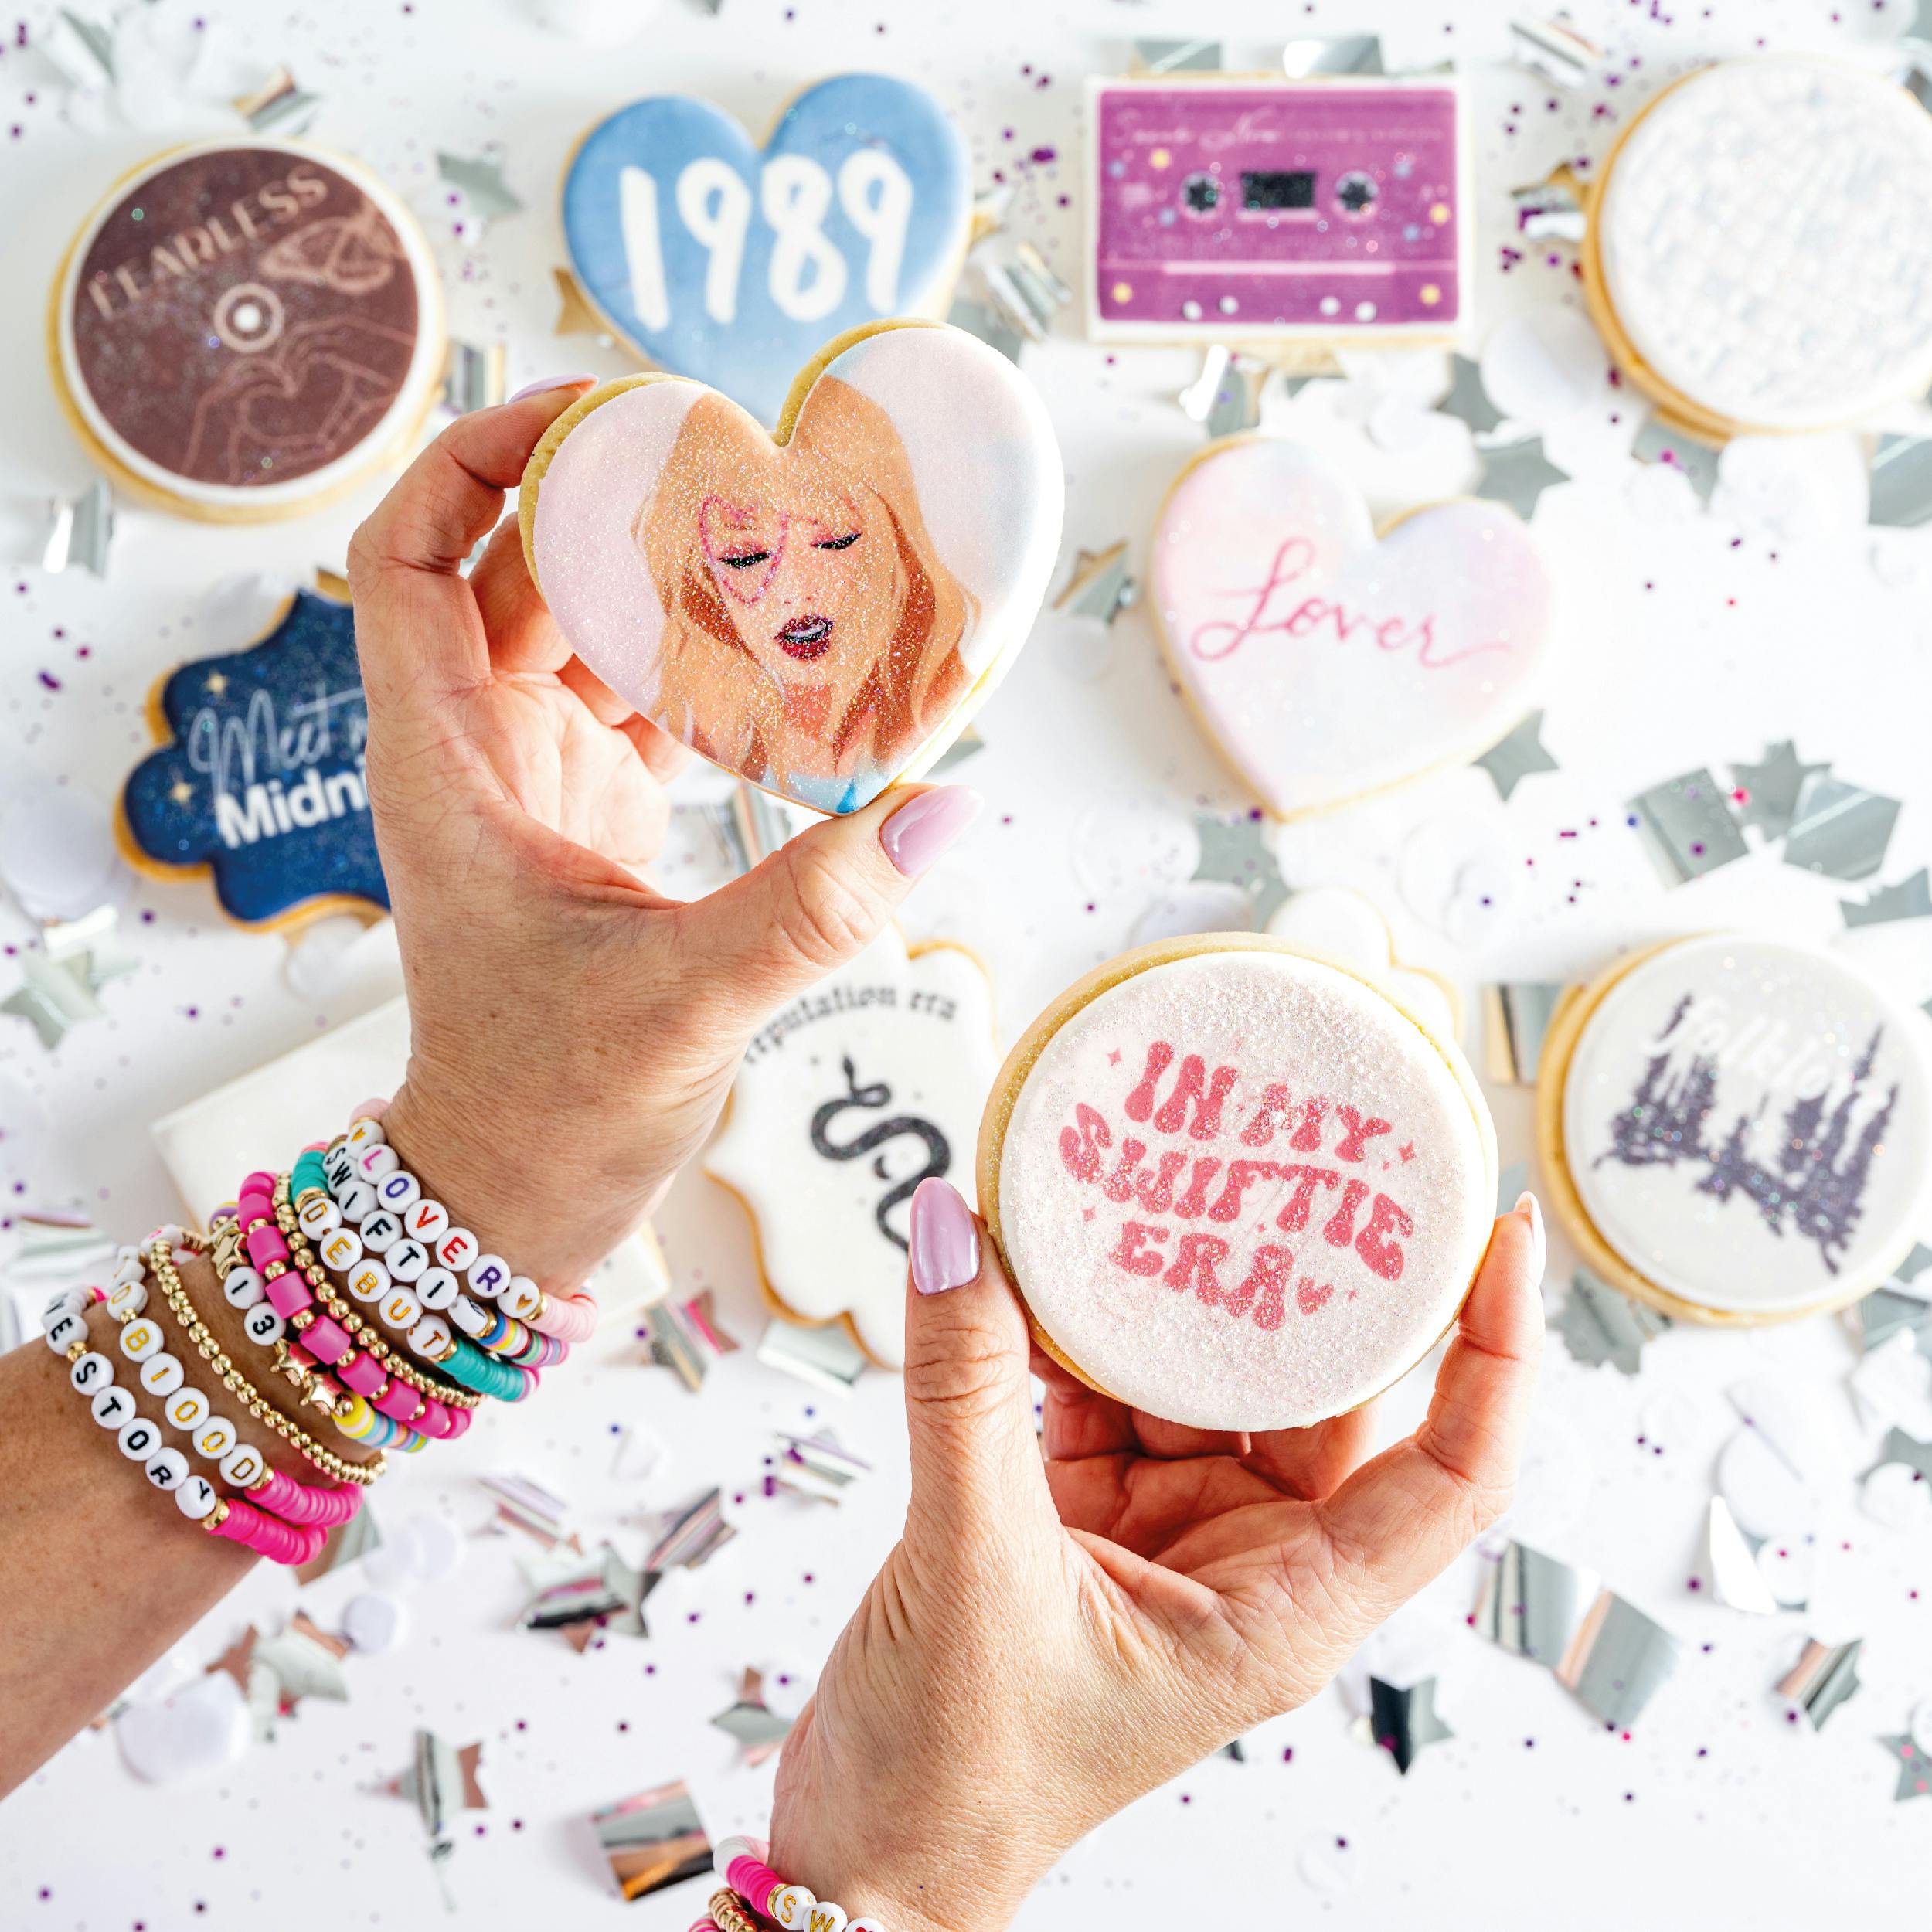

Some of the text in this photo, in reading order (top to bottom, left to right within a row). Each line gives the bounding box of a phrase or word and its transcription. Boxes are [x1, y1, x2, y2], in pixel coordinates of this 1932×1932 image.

[621, 148, 913, 332] 1989
[1191, 537, 1512, 669] Lover
[188, 685, 366, 800] Meet
[1124, 1041, 1392, 1162] IN MY
[362, 1148, 502, 1291] LOVER
[1058, 1103, 1414, 1281] SWIFTIE
[231, 1279, 276, 1335] 13
[303, 1202, 444, 1350] DEBUT
[1108, 1221, 1295, 1331] ERA
[75, 1361, 211, 1501] STORY
